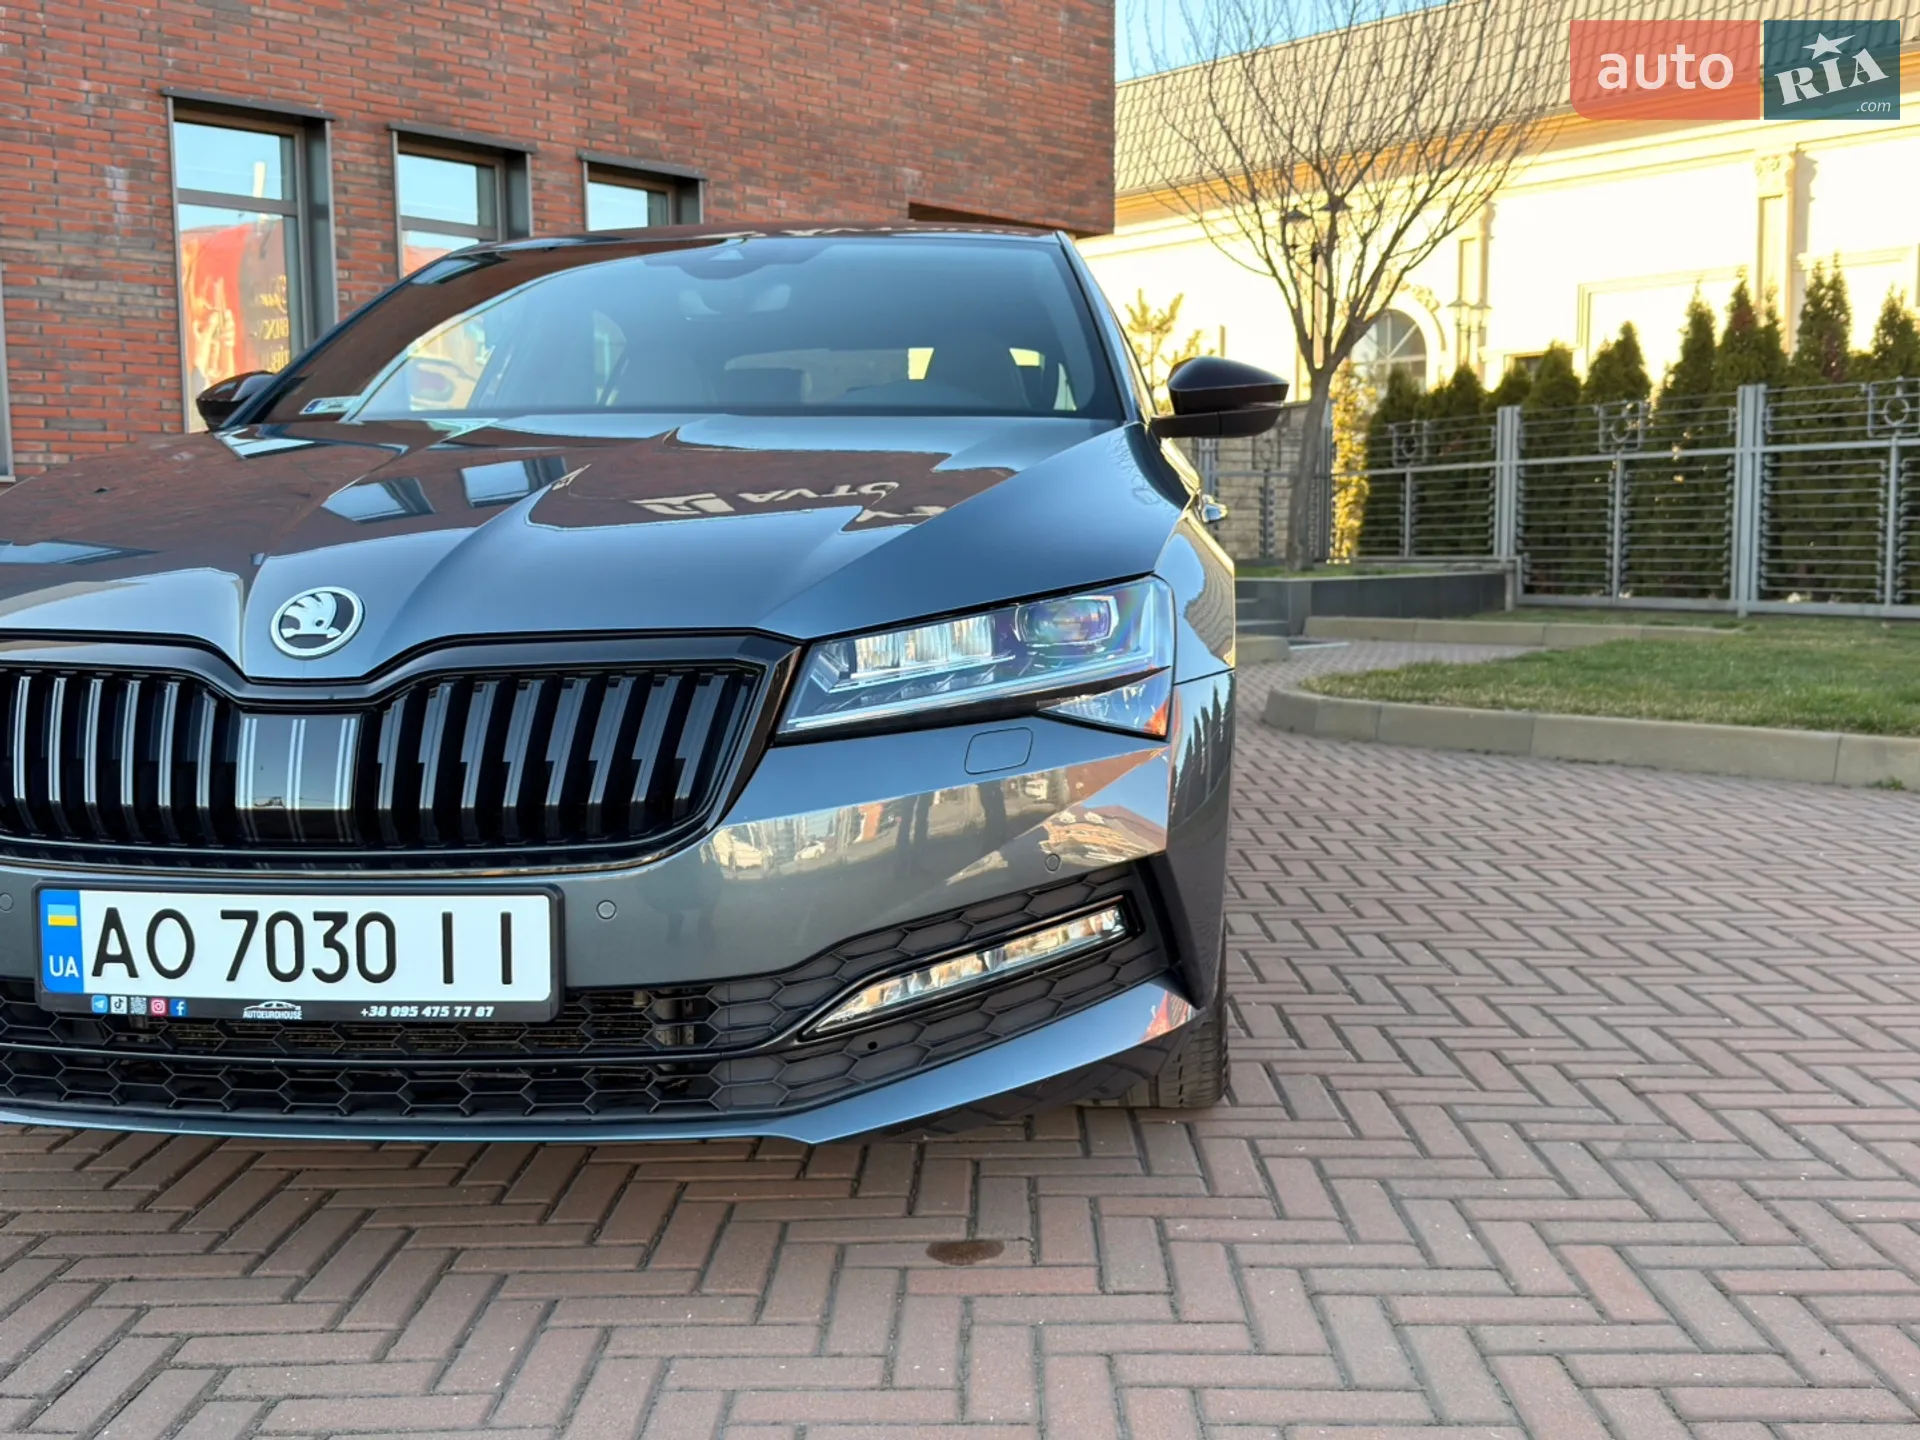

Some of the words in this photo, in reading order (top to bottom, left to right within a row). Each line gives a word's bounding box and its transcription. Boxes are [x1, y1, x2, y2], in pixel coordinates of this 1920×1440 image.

[91, 906, 195, 979] AO
[220, 910, 396, 984] 7030
[49, 955, 79, 977] UA
[242, 1010, 302, 1019] AUTOEUROHOUSE
[361, 1006, 387, 1017] +38
[390, 1006, 418, 1017] 095
[422, 1006, 449, 1017] 475
[454, 1006, 472, 1017] 77
[475, 1006, 495, 1017] 87
